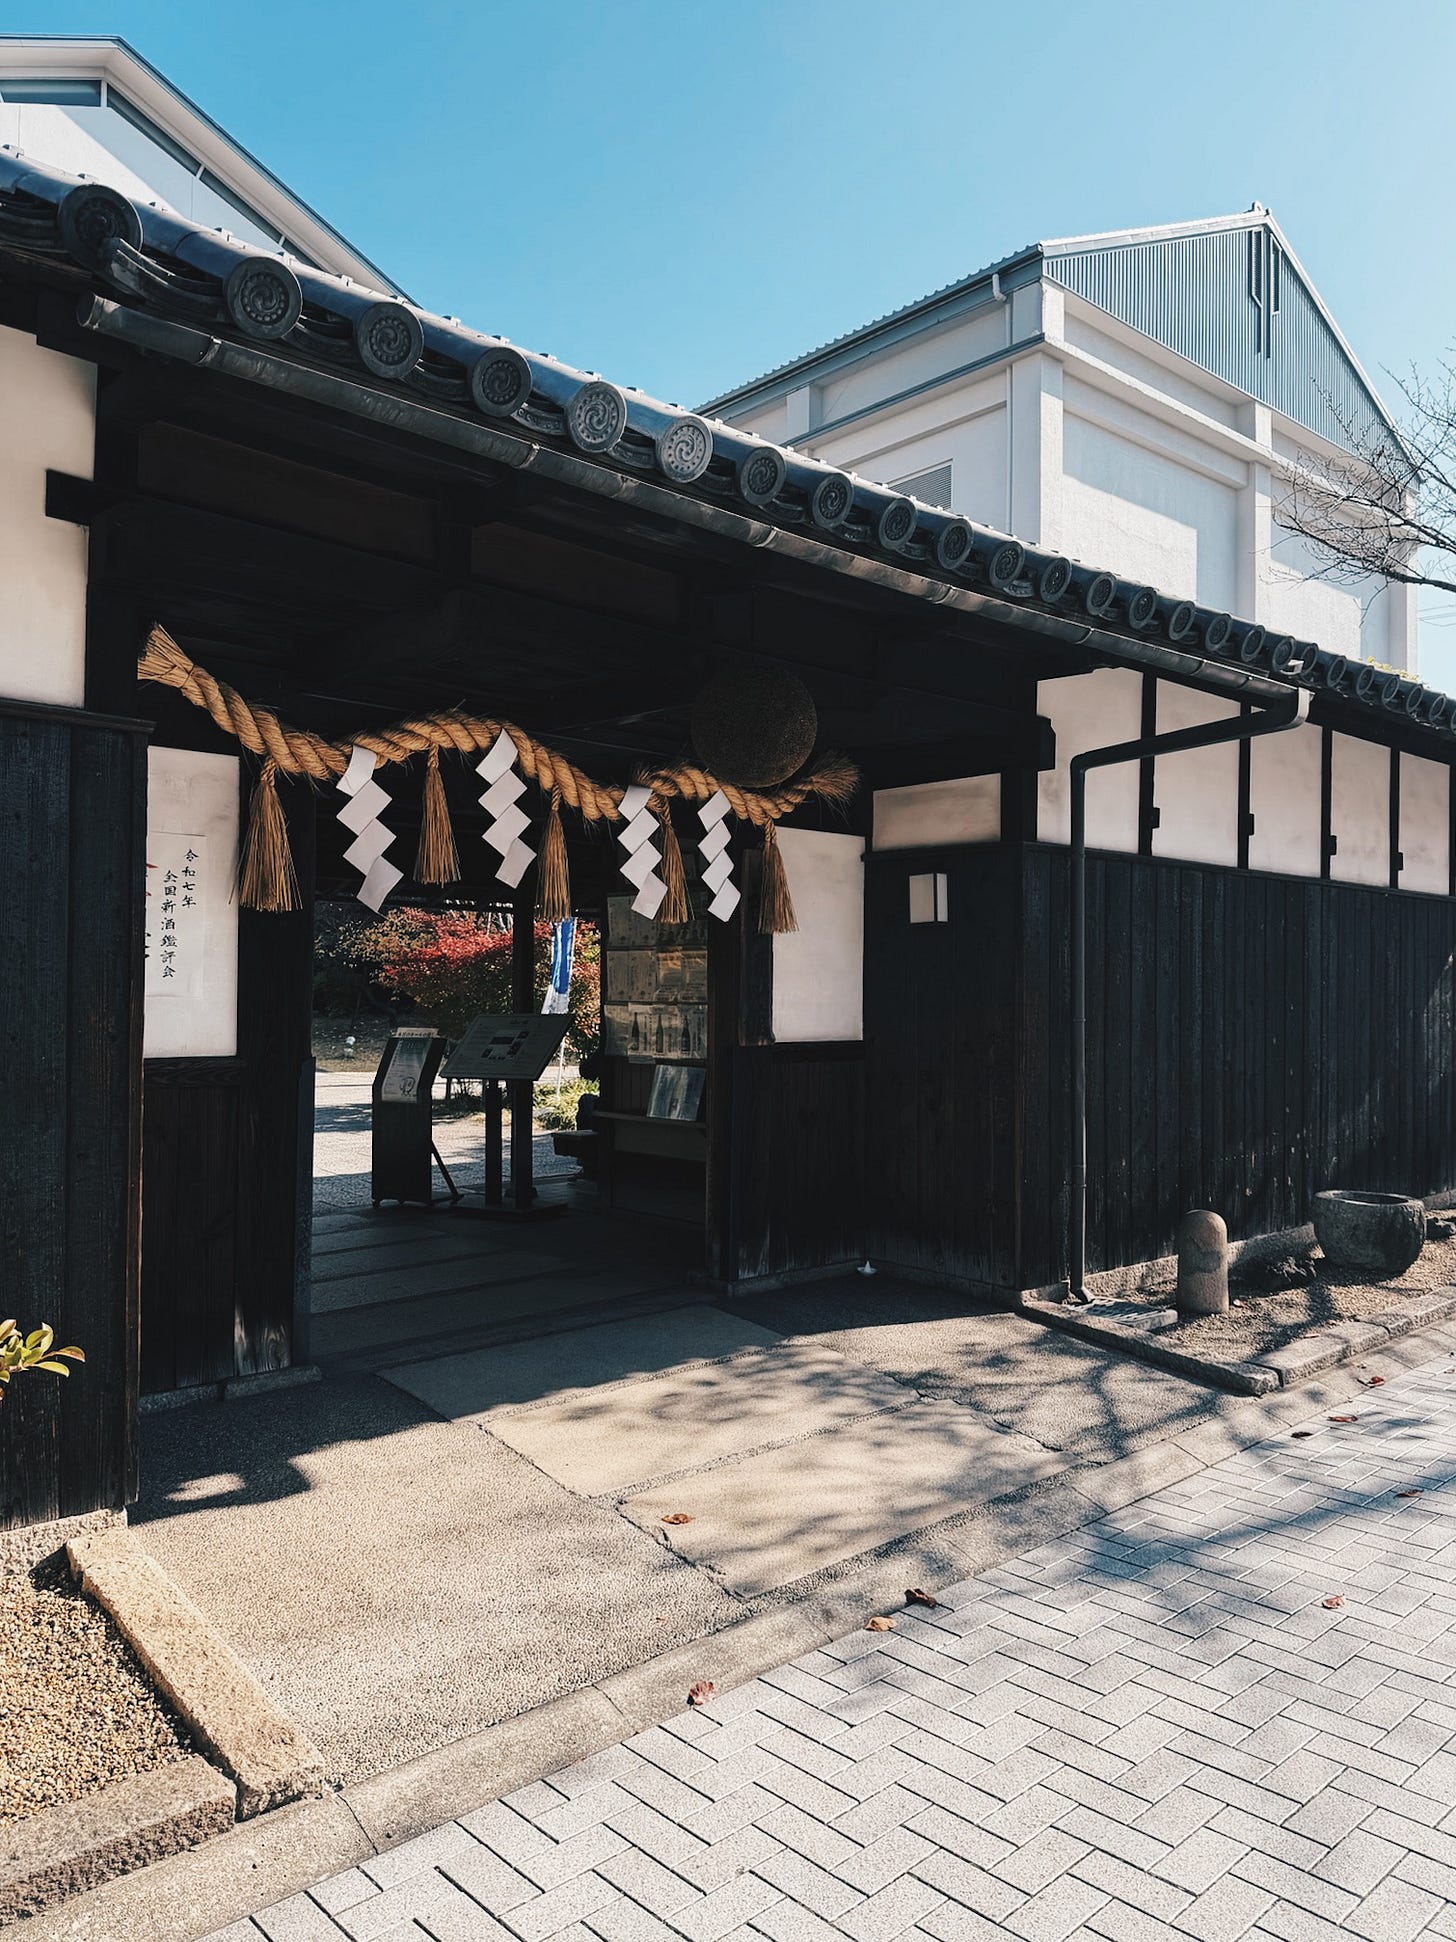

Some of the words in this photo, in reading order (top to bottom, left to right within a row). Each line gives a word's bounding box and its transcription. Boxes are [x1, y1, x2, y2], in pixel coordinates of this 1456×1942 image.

[181, 848, 199, 908] 令和七年
[160, 869, 178, 978] 全国新酒鑑評会
